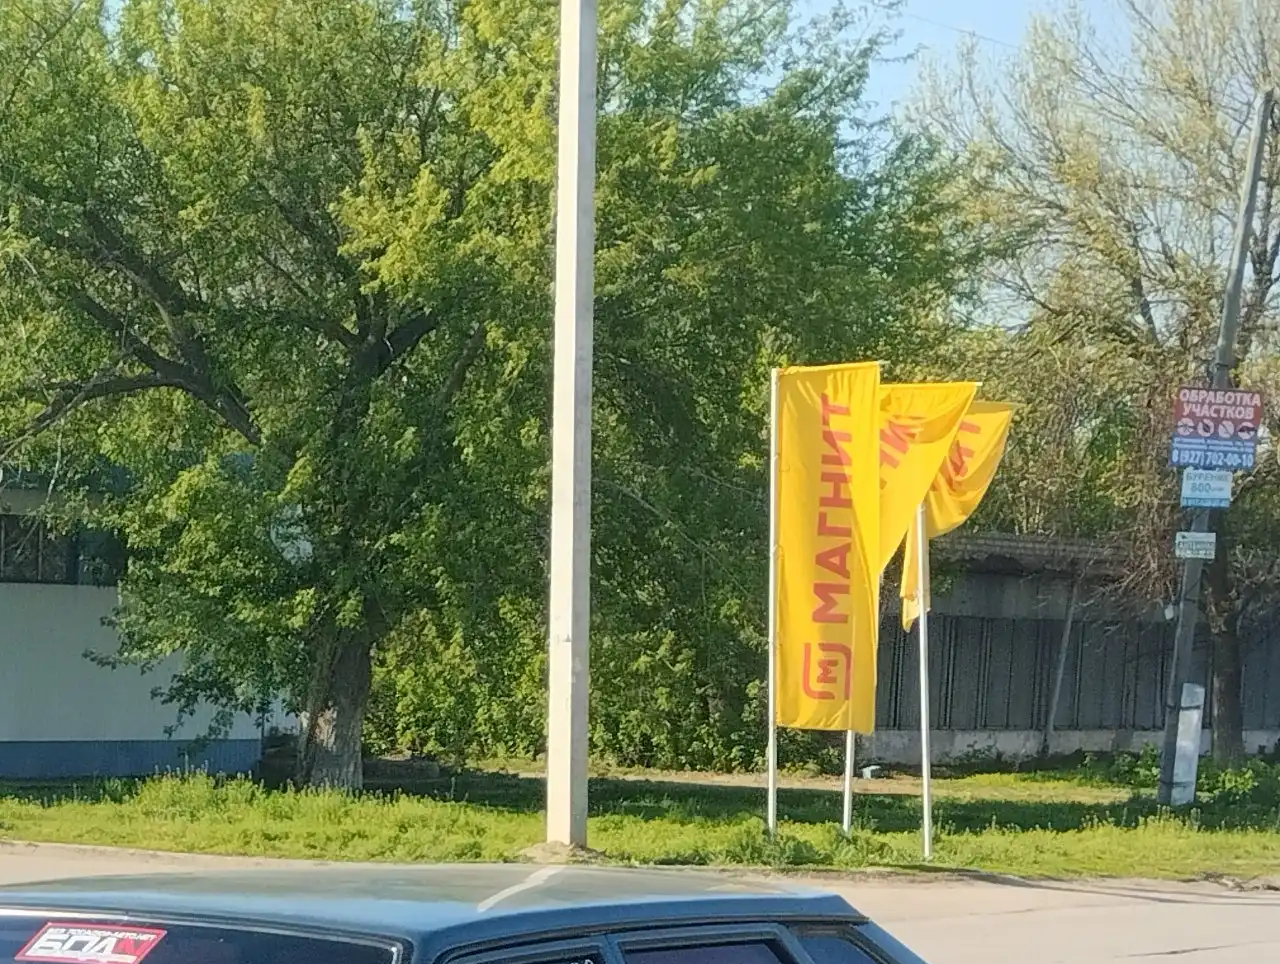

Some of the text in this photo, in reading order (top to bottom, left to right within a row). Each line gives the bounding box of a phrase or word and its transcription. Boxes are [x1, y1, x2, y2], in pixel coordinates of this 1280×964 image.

[1179, 388, 1261, 407] ОБРАБОТКА
[1182, 403, 1255, 419] УЧАСТКОВ
[811, 393, 853, 624] МАГНИТ
